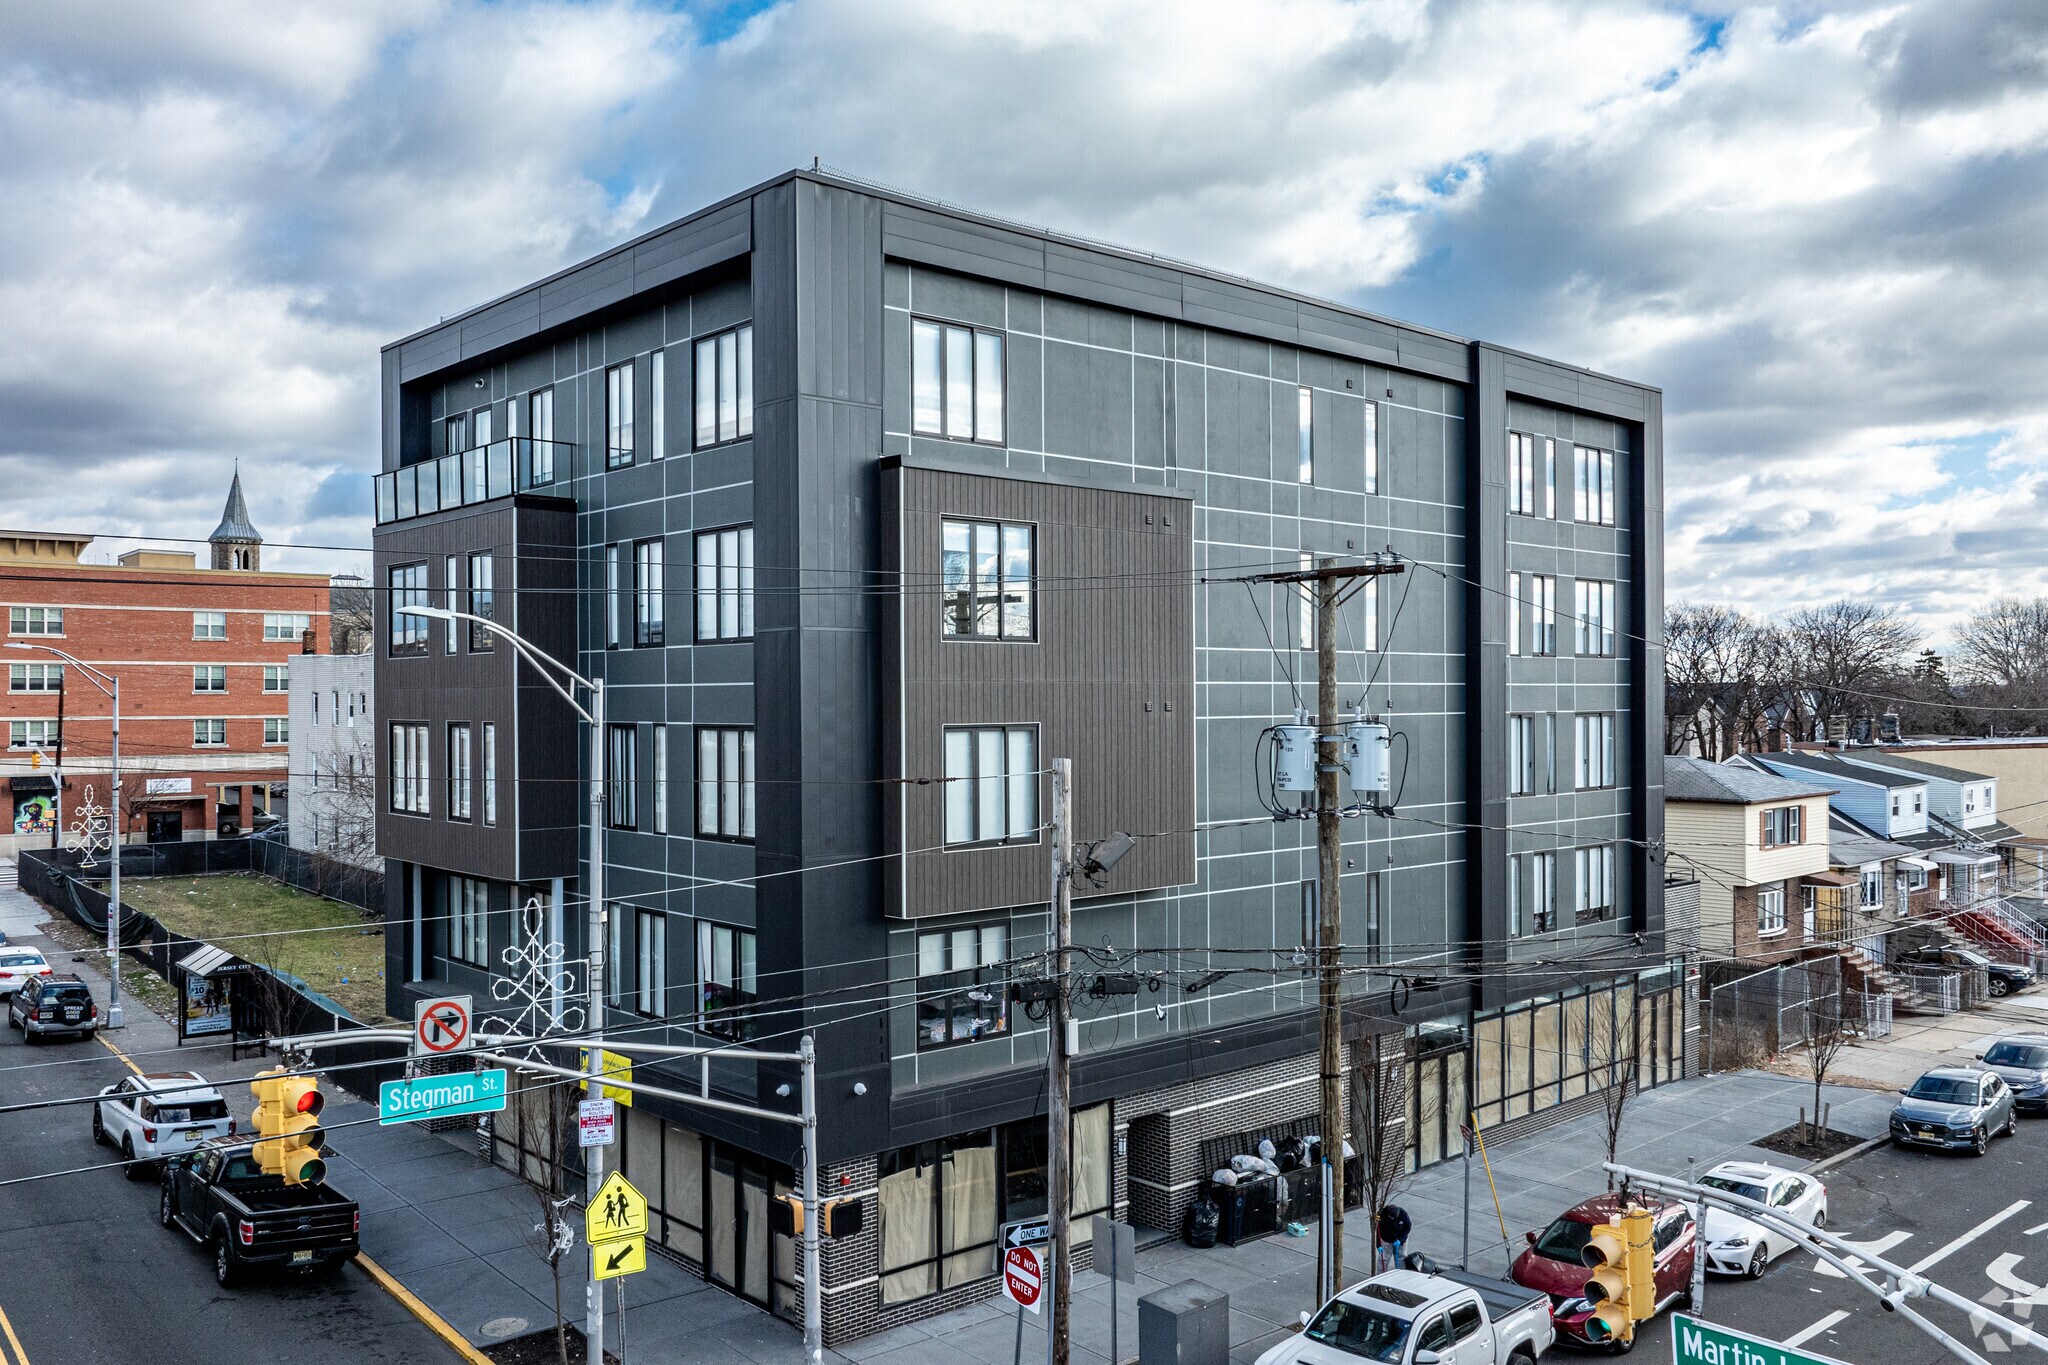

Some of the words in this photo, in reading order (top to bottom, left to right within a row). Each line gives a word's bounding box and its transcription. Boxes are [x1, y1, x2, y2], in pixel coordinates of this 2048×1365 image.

[389, 1084, 474, 1114] Stegman
[482, 1077, 498, 1091] St.
[1020, 1229, 1036, 1240] ONE
[1040, 1227, 1049, 1236] WA
[1011, 1252, 1020, 1264] DO
[1023, 1258, 1037, 1273] NOT
[1011, 1278, 1033, 1298] ENTER
